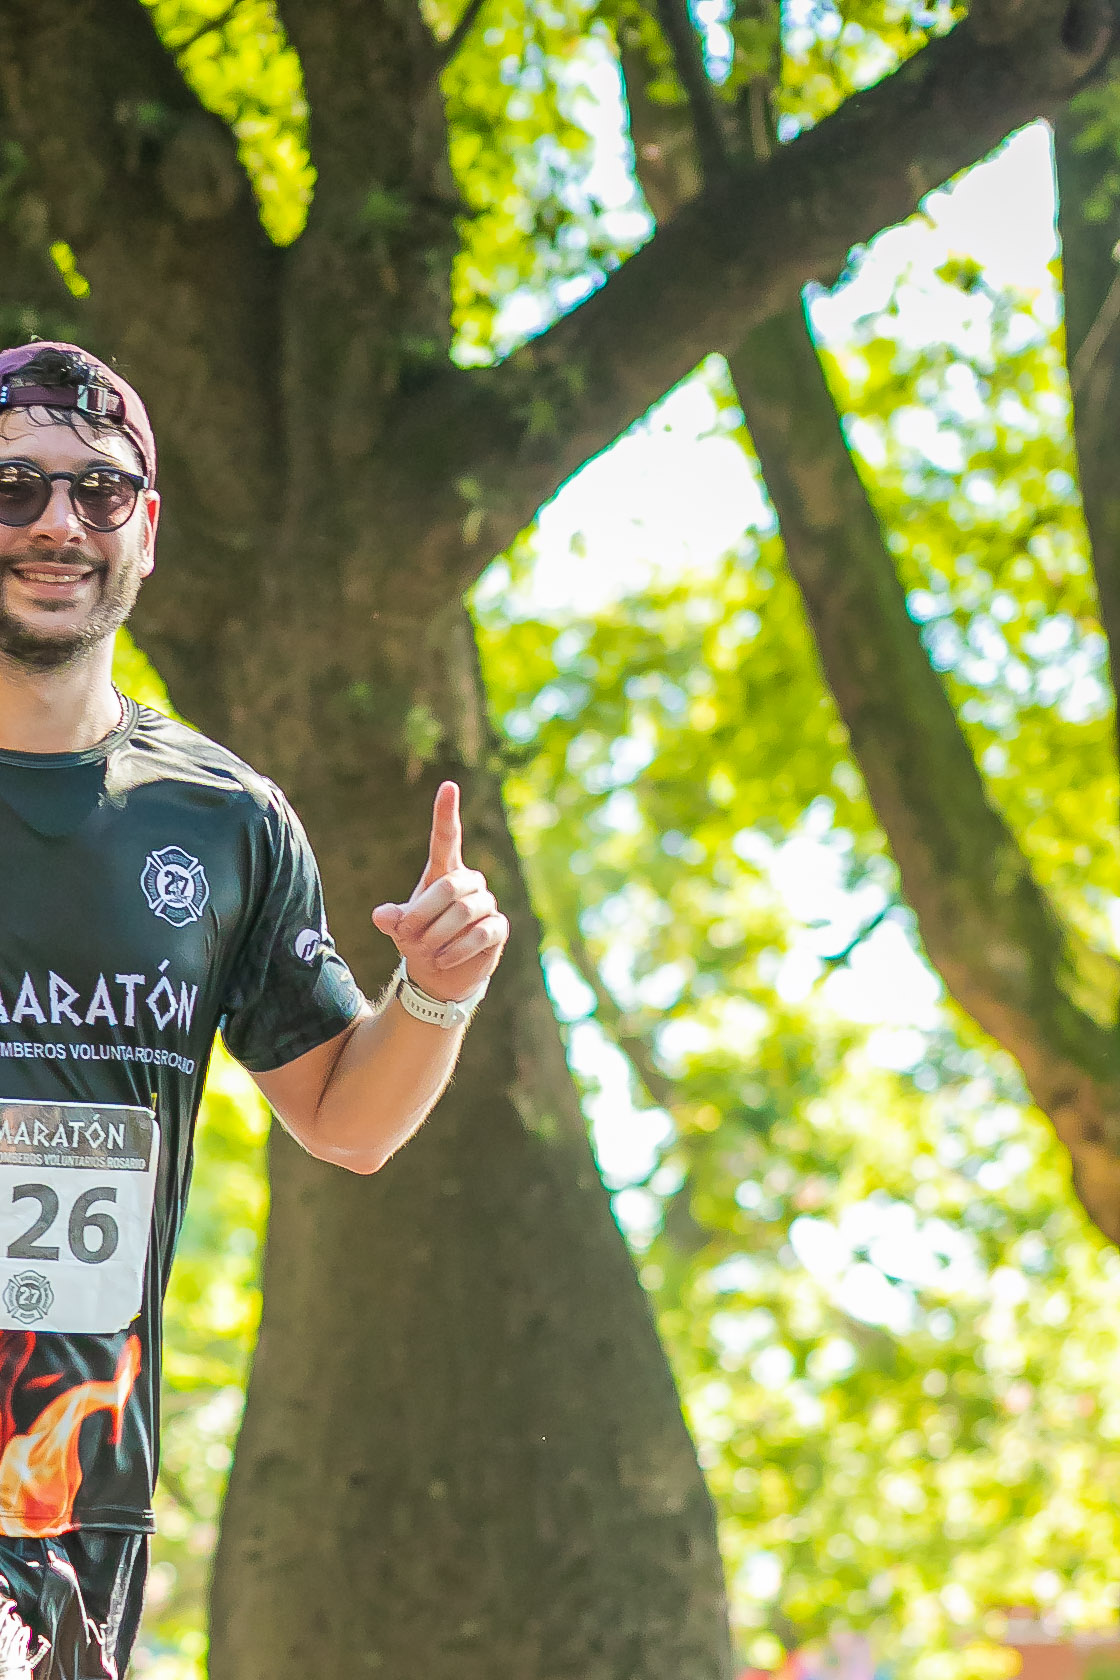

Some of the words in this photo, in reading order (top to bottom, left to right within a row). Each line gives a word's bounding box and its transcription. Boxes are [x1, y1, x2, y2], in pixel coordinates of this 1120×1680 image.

[164, 870, 189, 896] 27
[43, 1154, 106, 1168] VOLUNTARIOS
[106, 1156, 146, 1170] ROSARIO
[18, 1286, 41, 1305] 27
